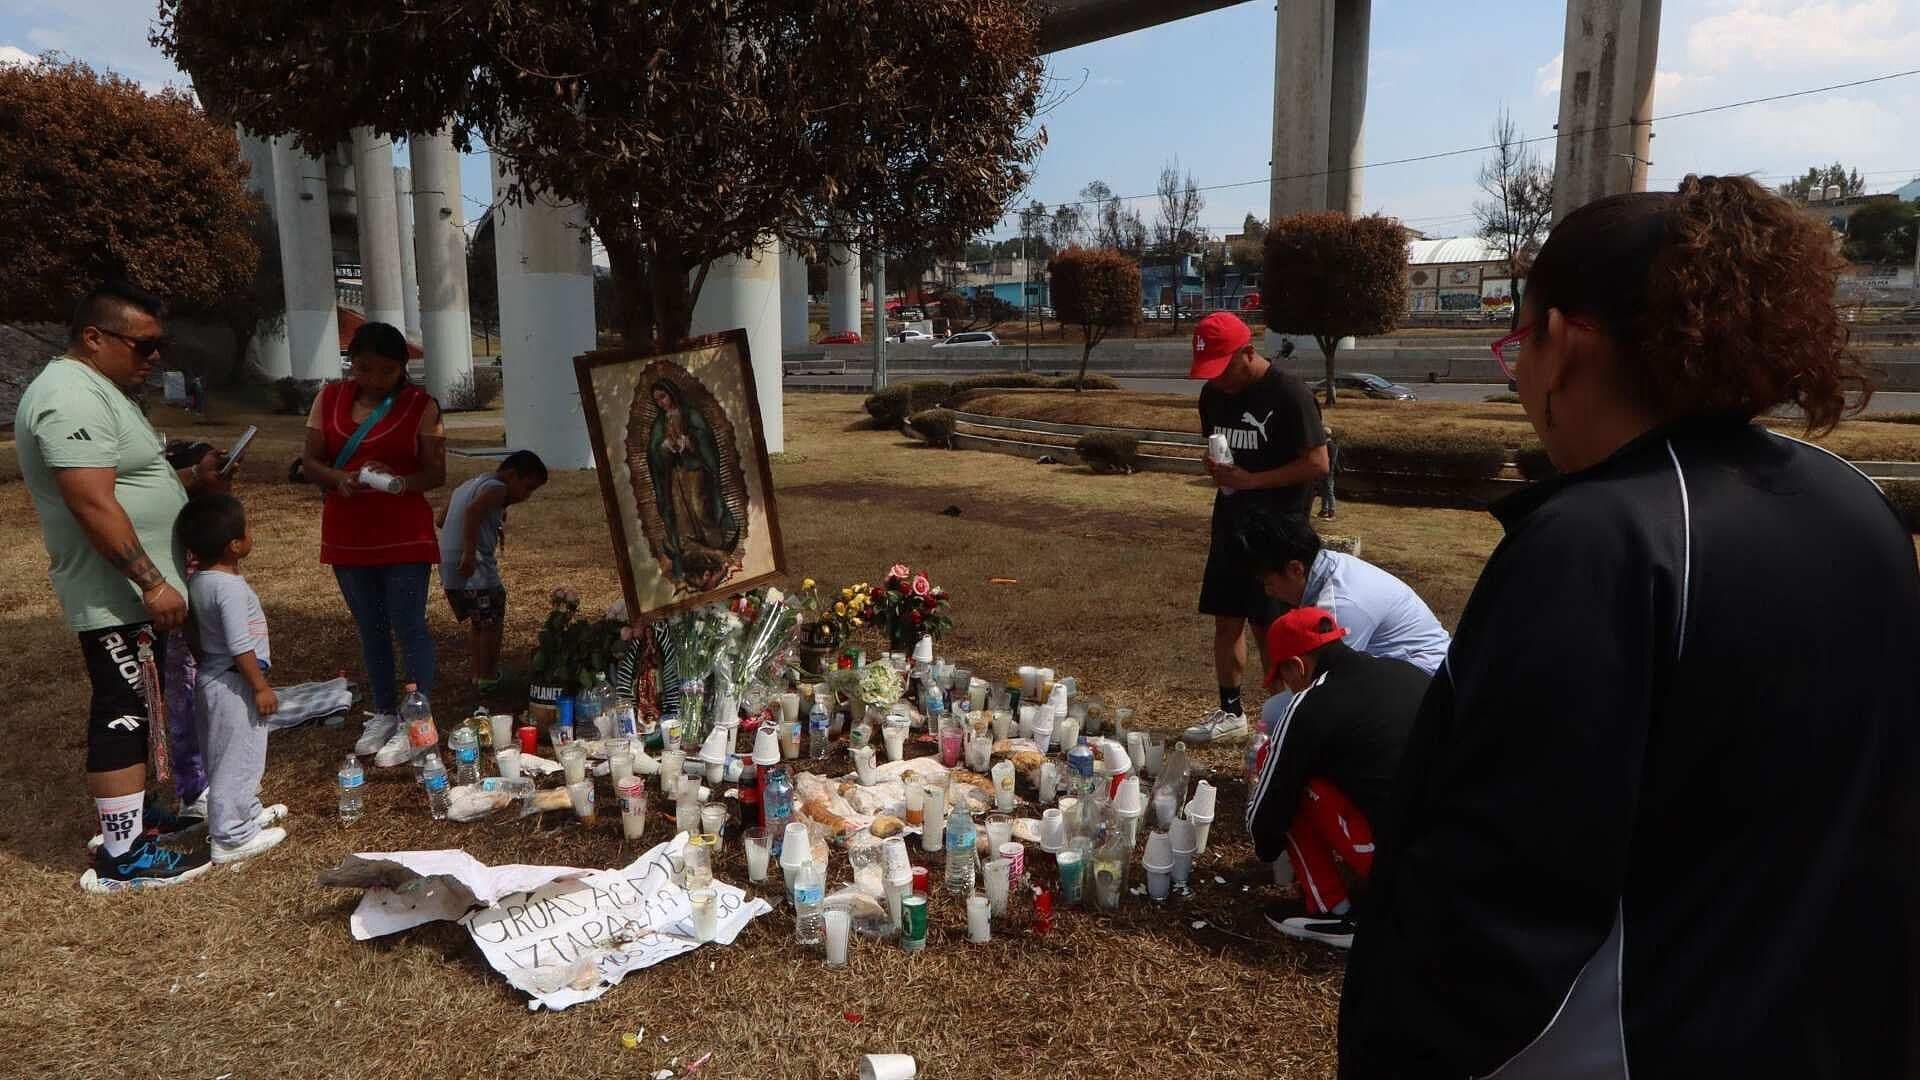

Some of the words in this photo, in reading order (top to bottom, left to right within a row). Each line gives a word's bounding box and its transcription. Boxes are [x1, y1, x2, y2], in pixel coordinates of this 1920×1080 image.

[1196, 335, 1206, 351] LA
[101, 808, 140, 822] JUST
[106, 820, 134, 832] DO
[115, 830, 129, 841] IT
[470, 898, 587, 943] GRUAS
